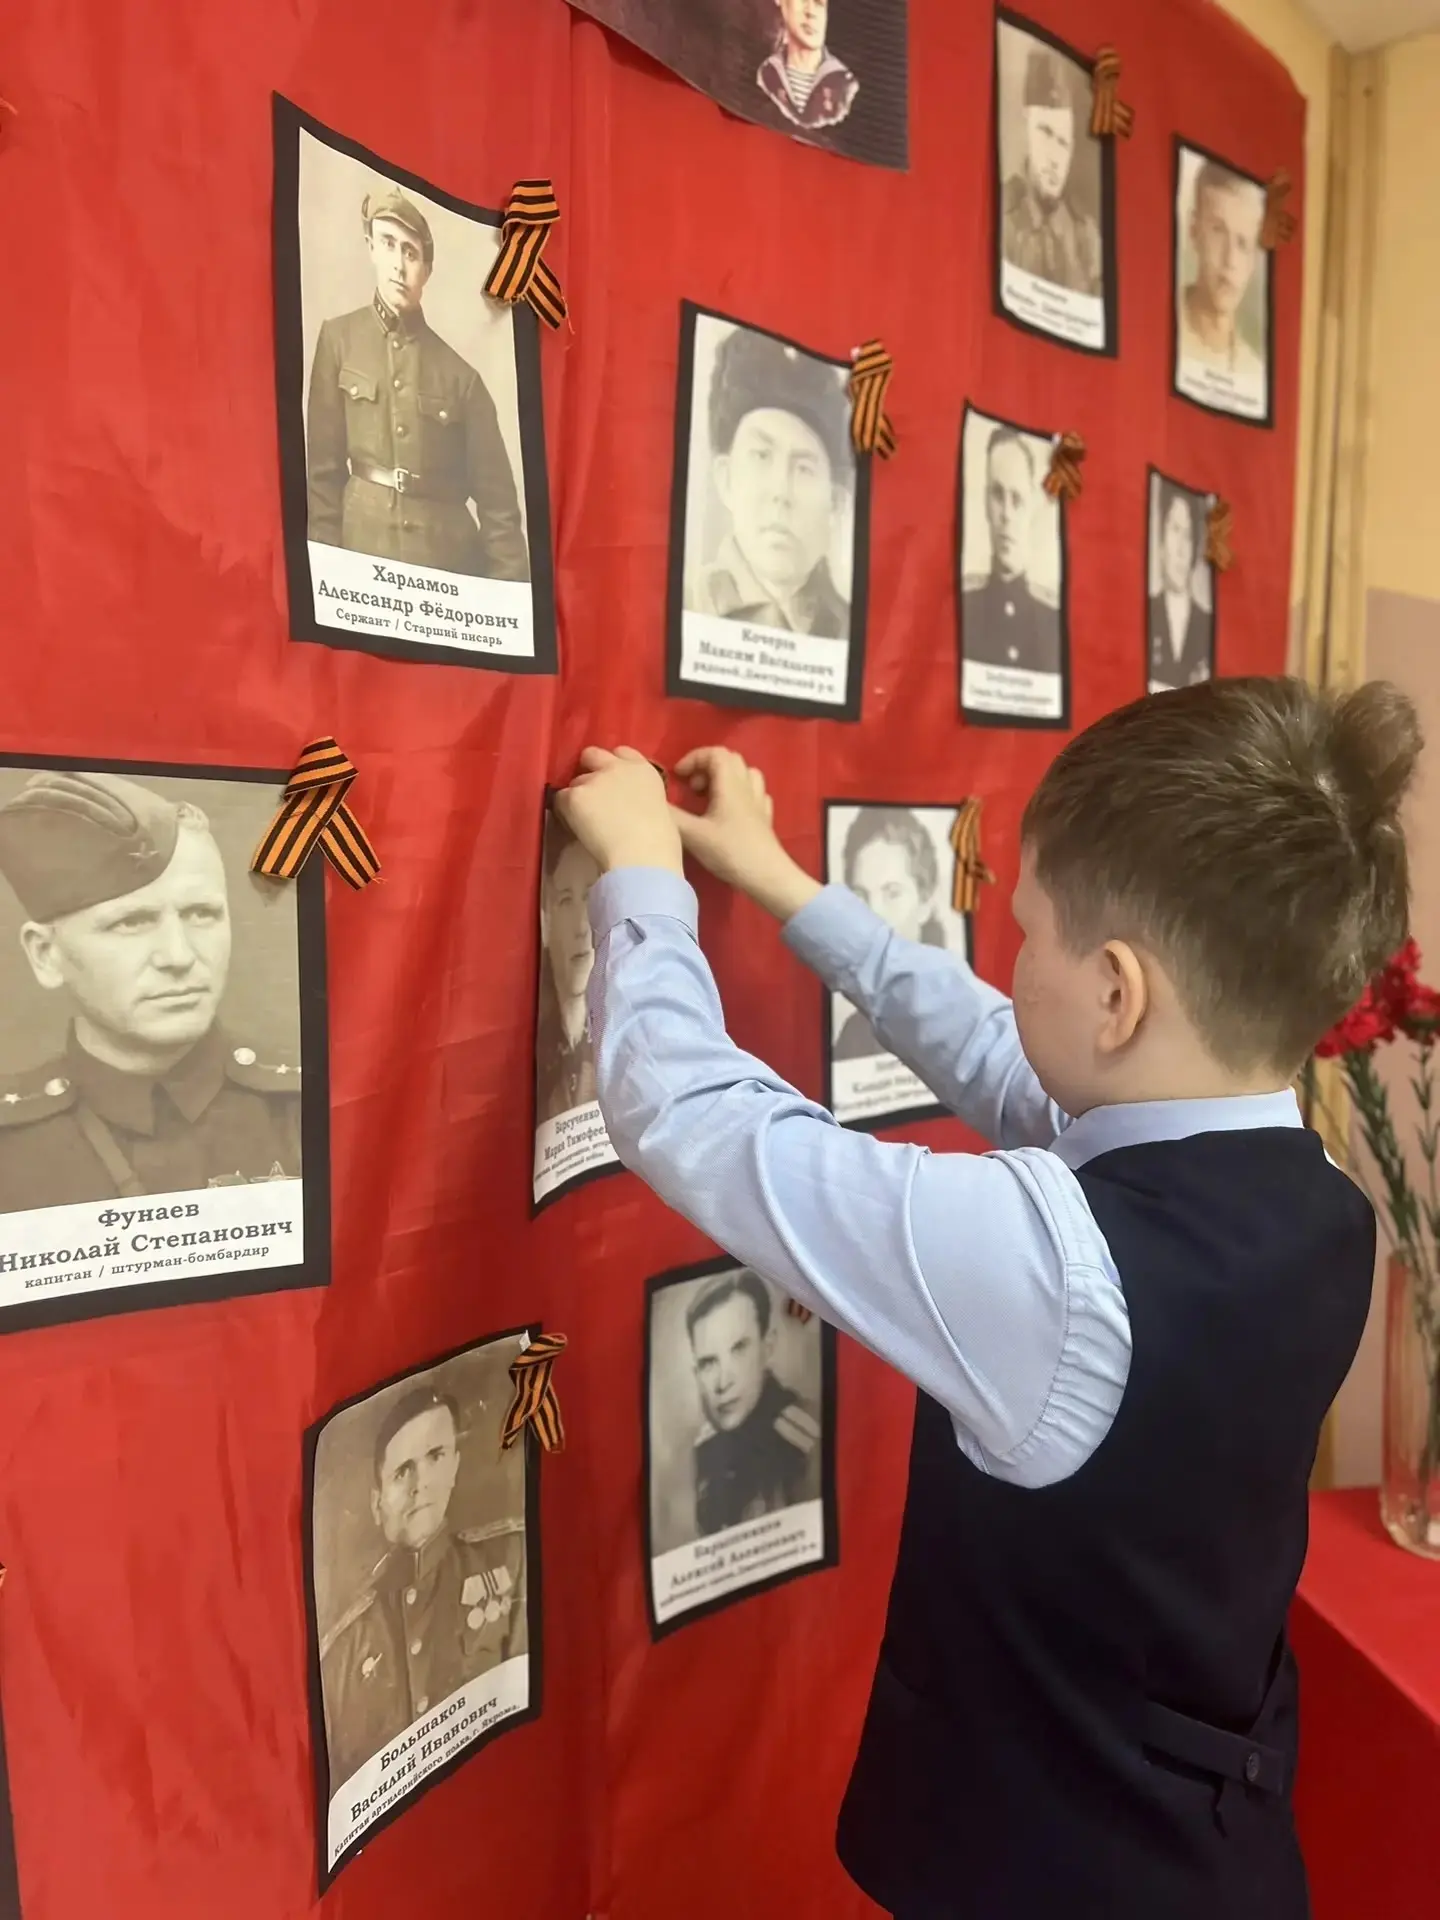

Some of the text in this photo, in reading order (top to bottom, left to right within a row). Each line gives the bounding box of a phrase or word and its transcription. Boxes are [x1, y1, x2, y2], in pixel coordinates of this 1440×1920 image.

[373, 564, 459, 596] Харламов
[318, 579, 519, 629] Александр Фёдорович
[336, 607, 502, 647] Сержант / Старший писарь
[699, 640, 755, 663] Максим
[566, 1126, 606, 1147] Тимофее
[98, 1203, 200, 1230] Фунаев
[0, 1220, 293, 1274] Николай Степанович
[25, 1245, 270, 1289] капитан / штурман-бомбардир
[380, 1696, 466, 1772] Большаков
[350, 1697, 499, 1822] Василий Иванович
[334, 1816, 370, 1857] Капитан
